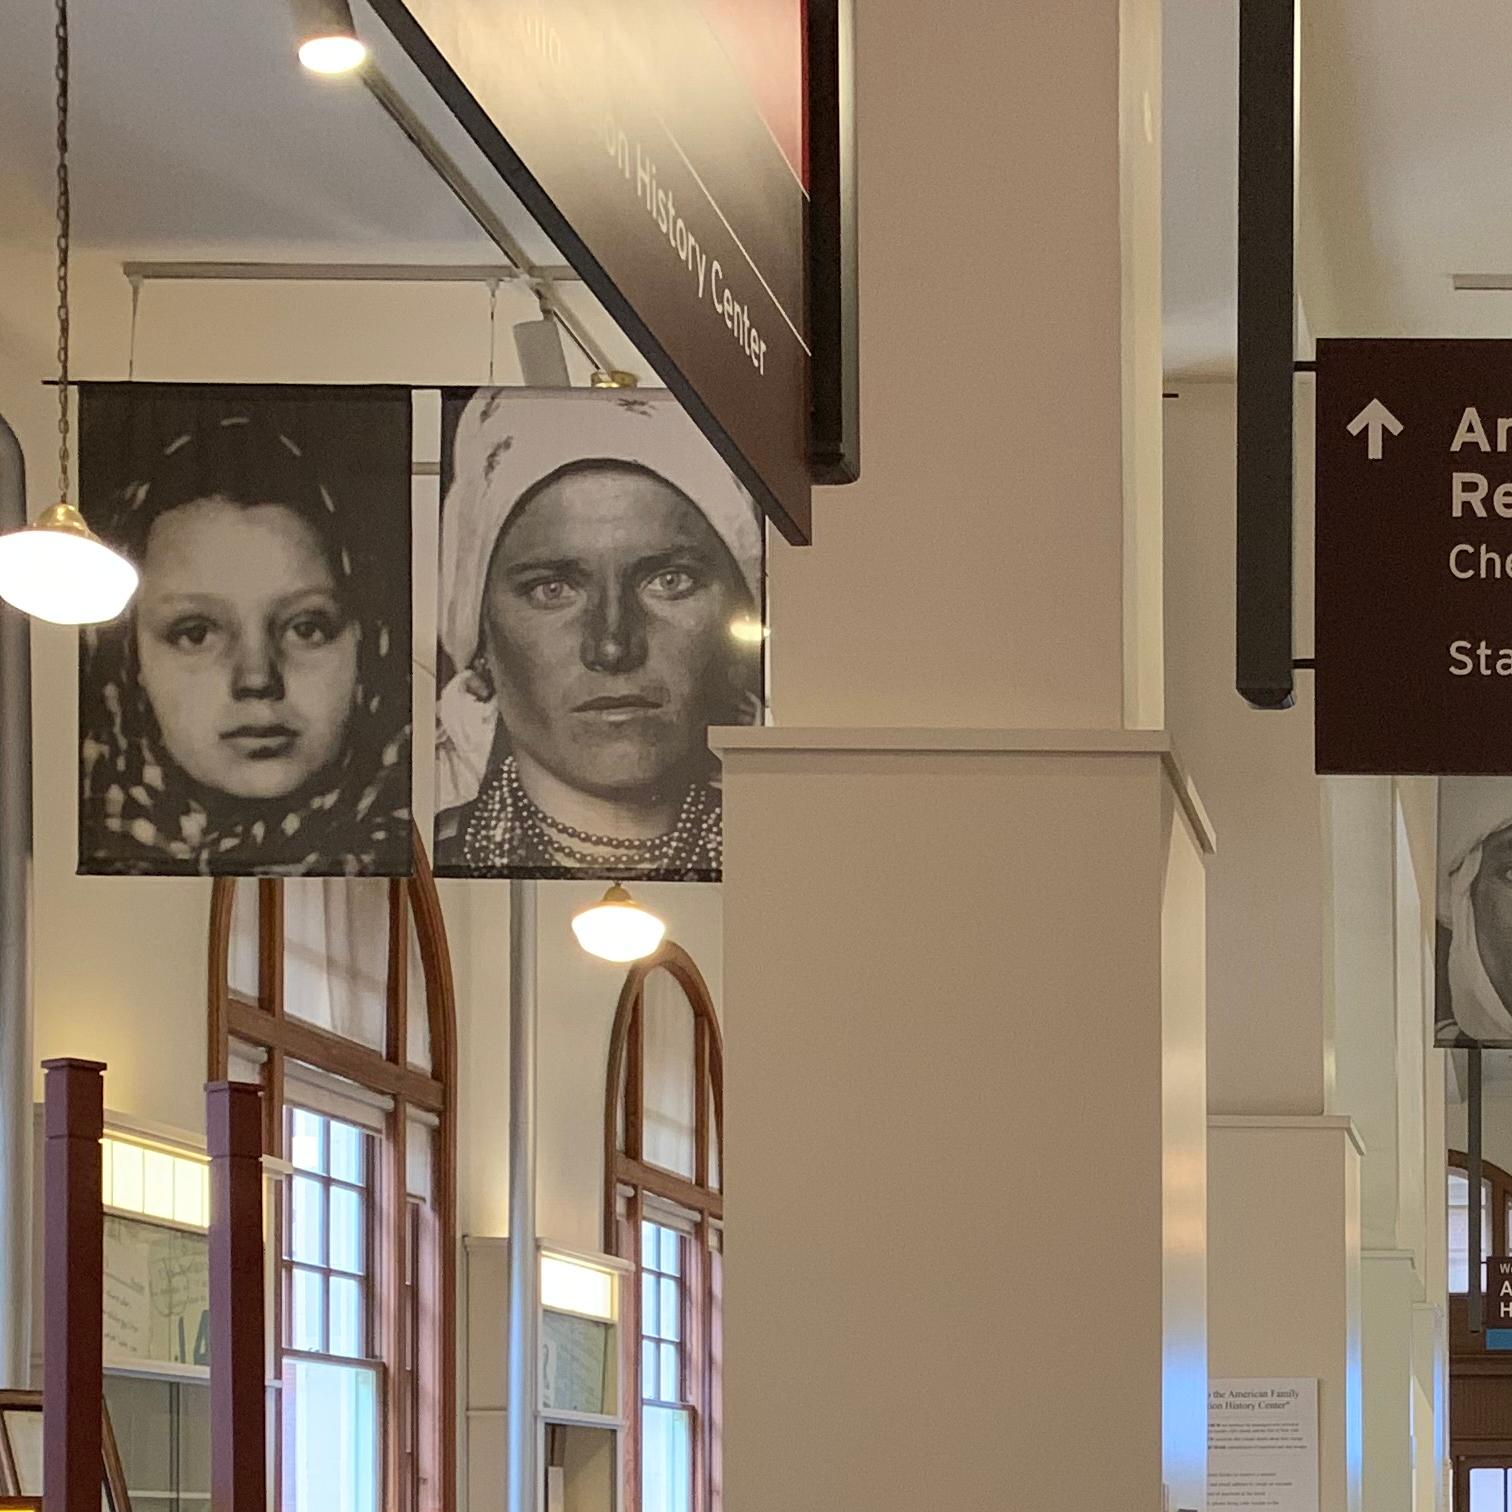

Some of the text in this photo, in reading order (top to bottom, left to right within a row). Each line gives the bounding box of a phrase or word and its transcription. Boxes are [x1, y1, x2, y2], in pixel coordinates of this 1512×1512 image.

[636, 144, 706, 298] History
[711, 260, 767, 376] Center
[1213, 1389, 1299, 1400] the American Family
[1225, 1401, 1255, 1411] History
